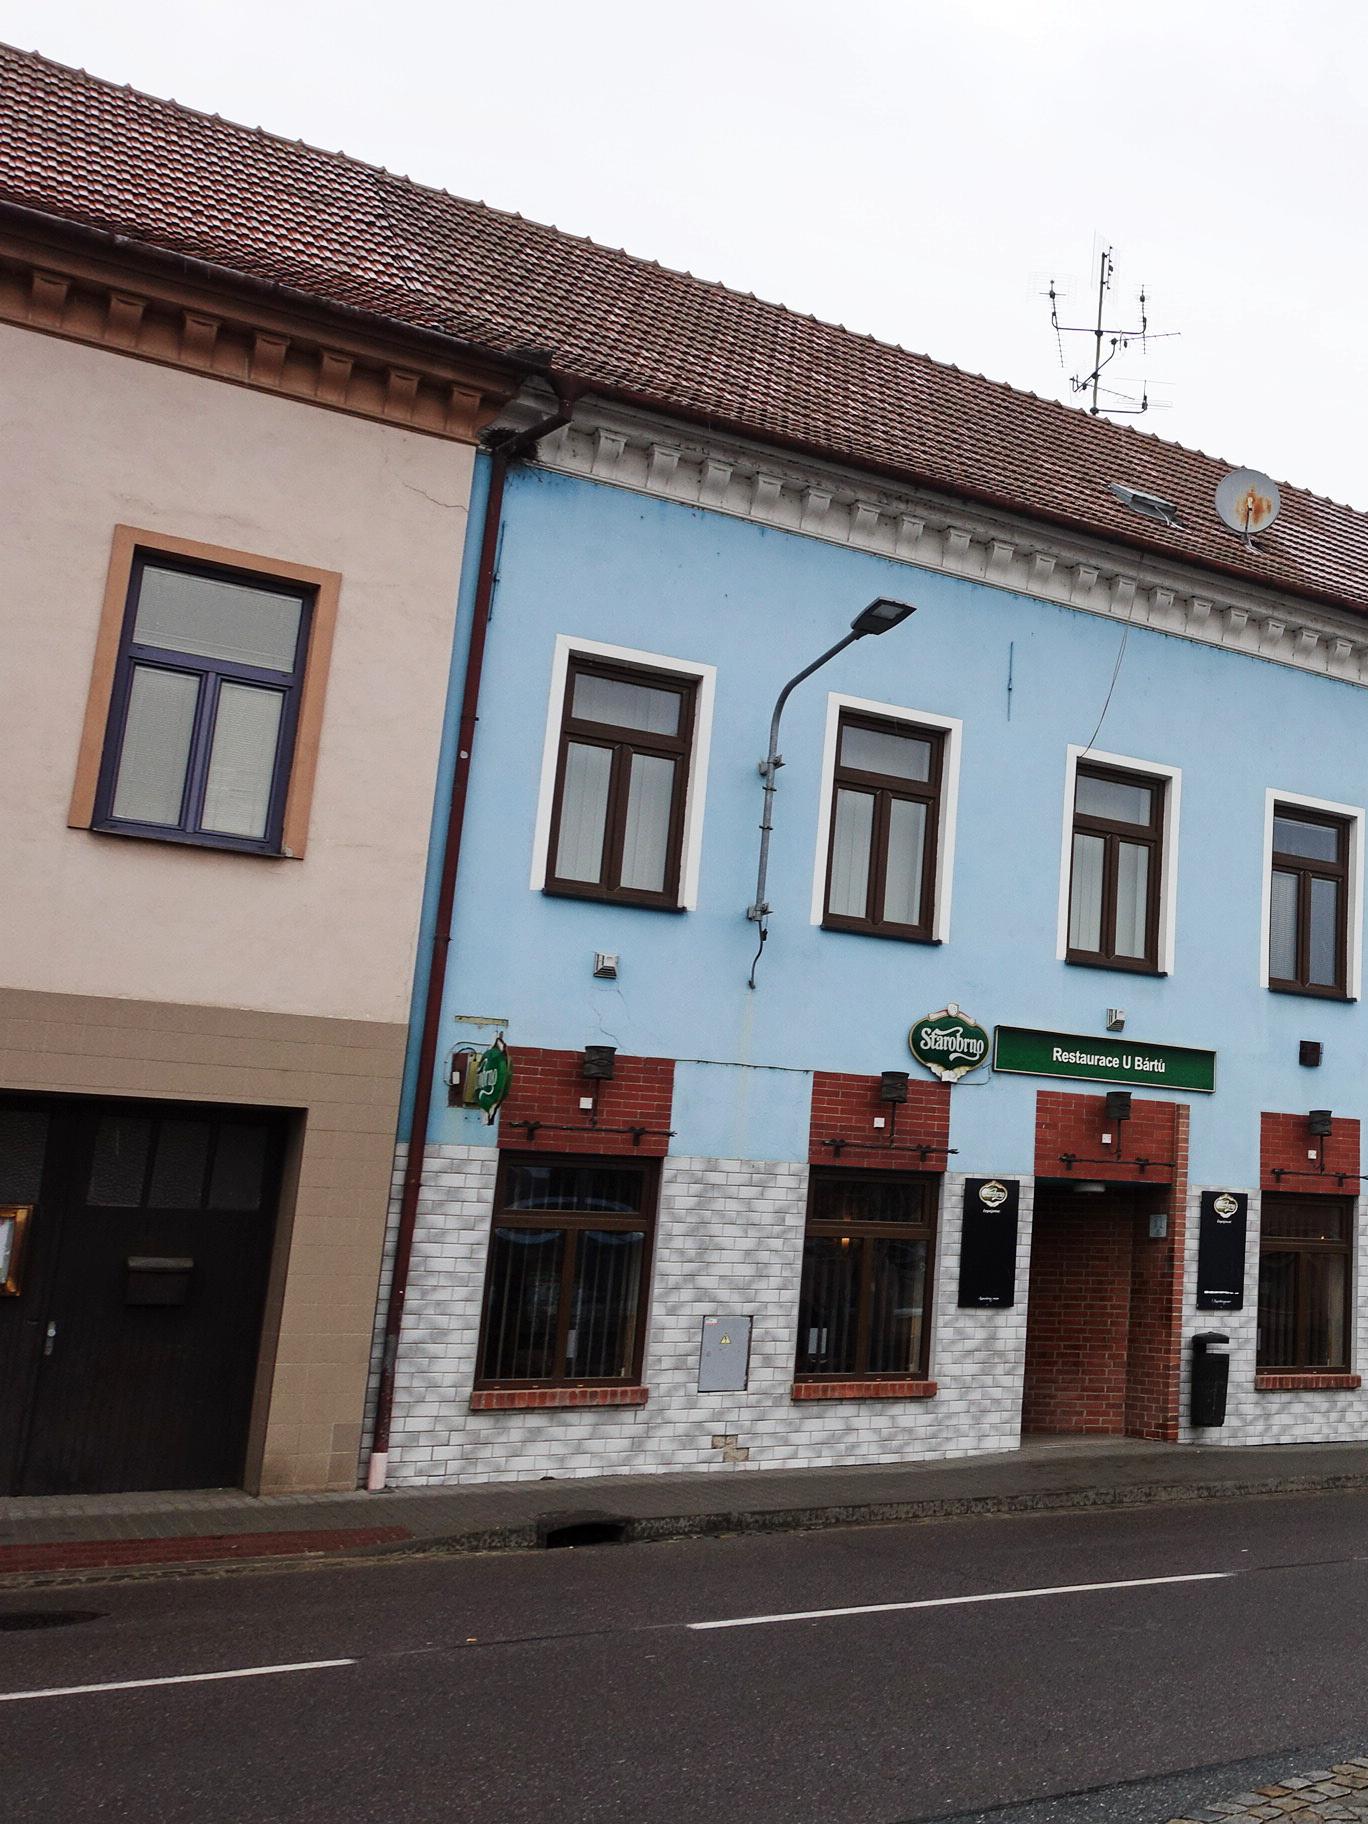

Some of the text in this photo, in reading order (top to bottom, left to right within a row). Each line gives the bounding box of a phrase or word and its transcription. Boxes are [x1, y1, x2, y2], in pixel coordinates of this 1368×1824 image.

[920, 1026, 985, 1062] Starobrno
[1052, 1047, 1165, 1072] Restaurace U Bártů
